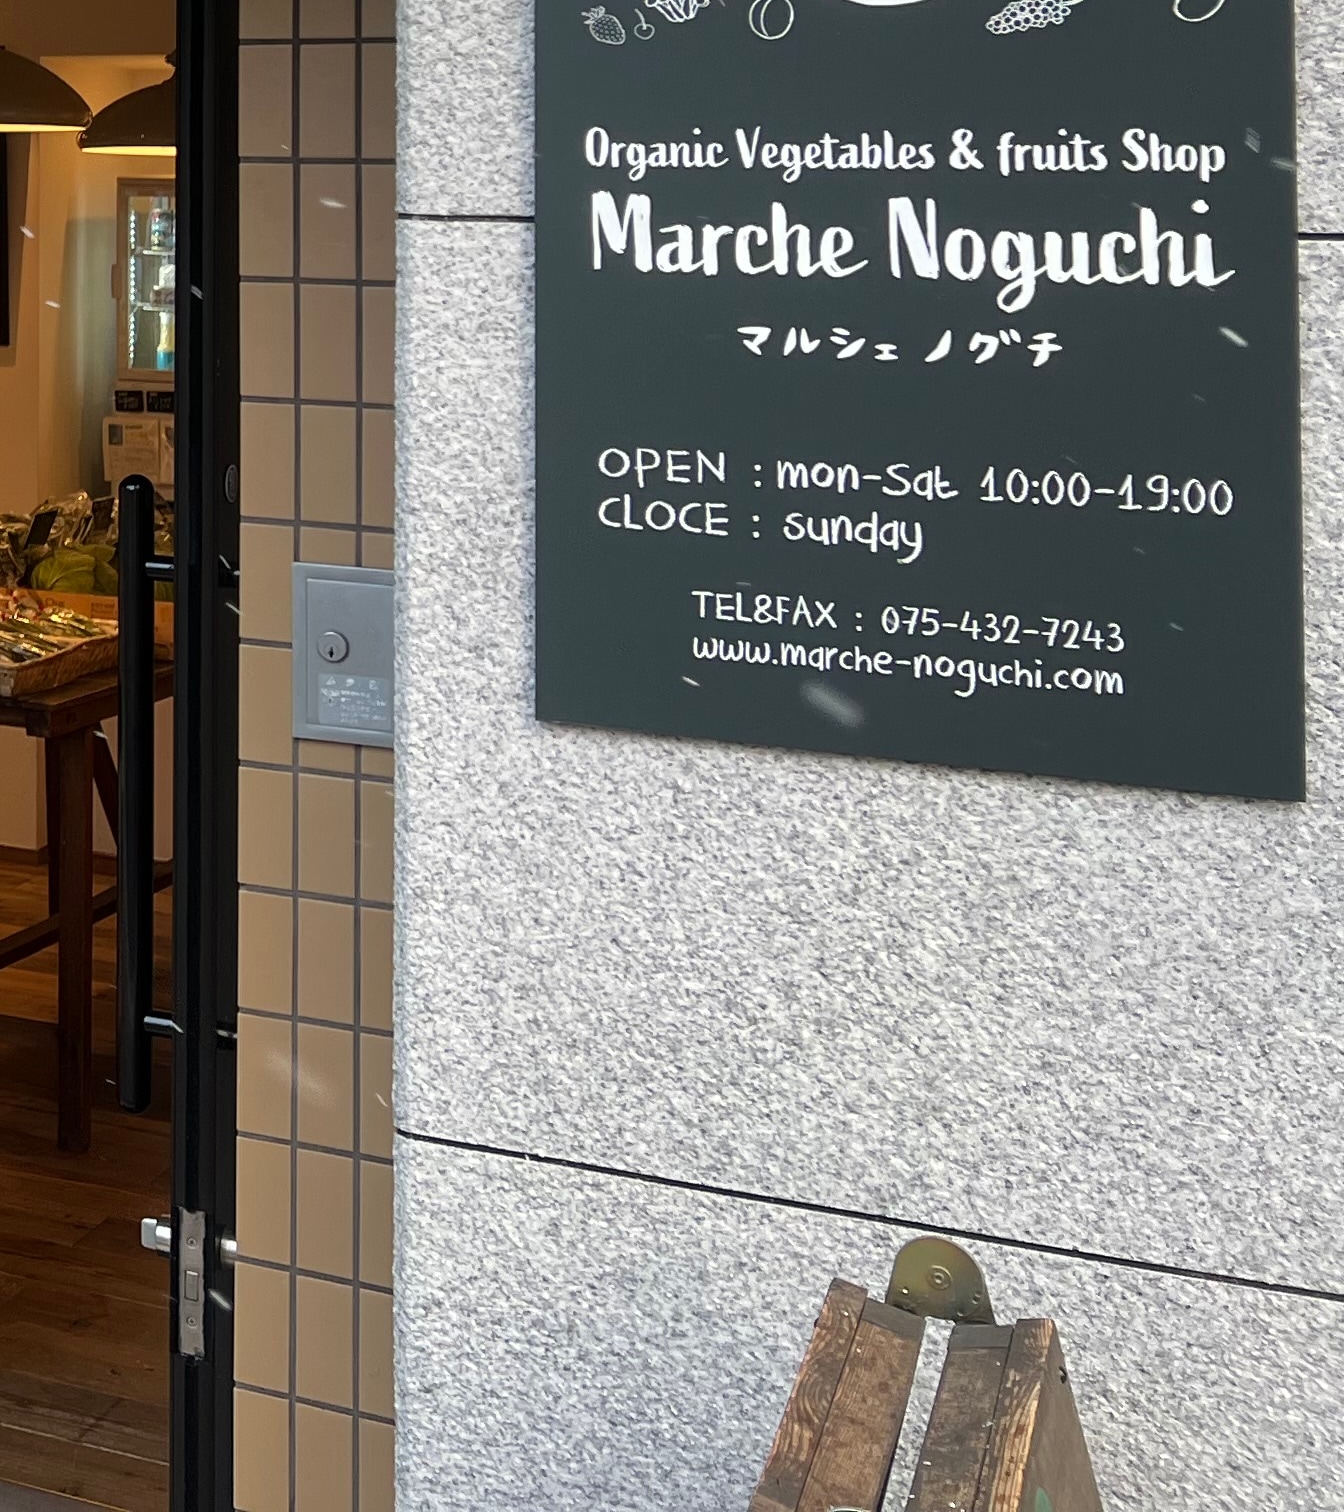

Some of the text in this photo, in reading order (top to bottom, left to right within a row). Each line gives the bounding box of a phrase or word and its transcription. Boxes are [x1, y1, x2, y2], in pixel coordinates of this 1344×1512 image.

[584, 127, 1227, 183] Organic Vegetables & fruits Shop
[590, 190, 1236, 314] Marche Noguchi
[736, 326, 1064, 367] マルシェ ノグチ
[598, 448, 726, 489] OPEN
[980, 464, 1235, 516] 10:00-19:00
[598, 496, 729, 538] CLOCE
[782, 510, 925, 565] sunday
[691, 590, 838, 630] TEL&FAX
[880, 604, 1126, 653] 075-432-7243
[692, 638, 1125, 698] www.marche-noguchi.com
